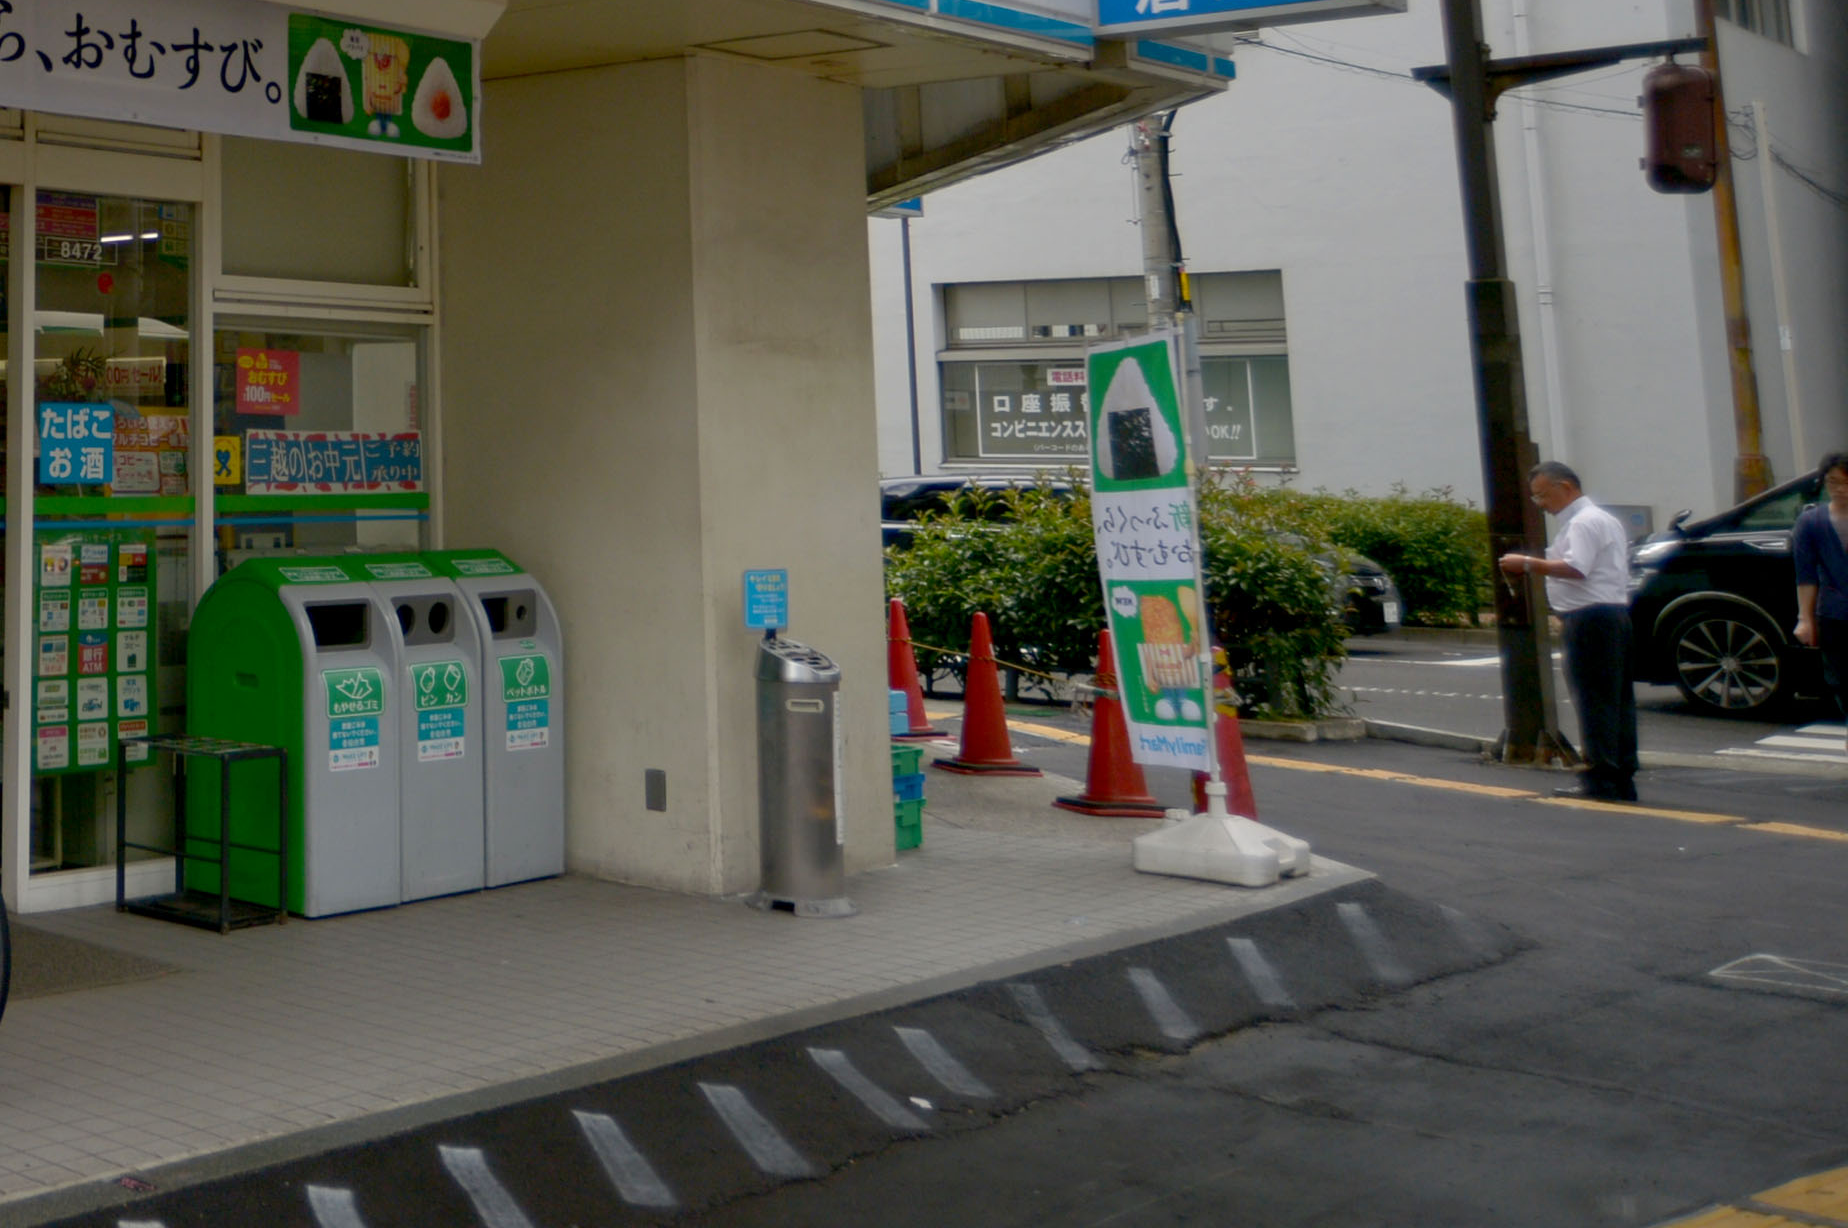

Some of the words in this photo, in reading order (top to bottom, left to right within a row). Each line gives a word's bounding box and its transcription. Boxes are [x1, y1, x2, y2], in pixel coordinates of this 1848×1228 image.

[60, 240, 103, 261] 8472
[41, 407, 113, 440] たばこ
[251, 441, 303, 483] 三越の
[307, 441, 362, 482] お中元
